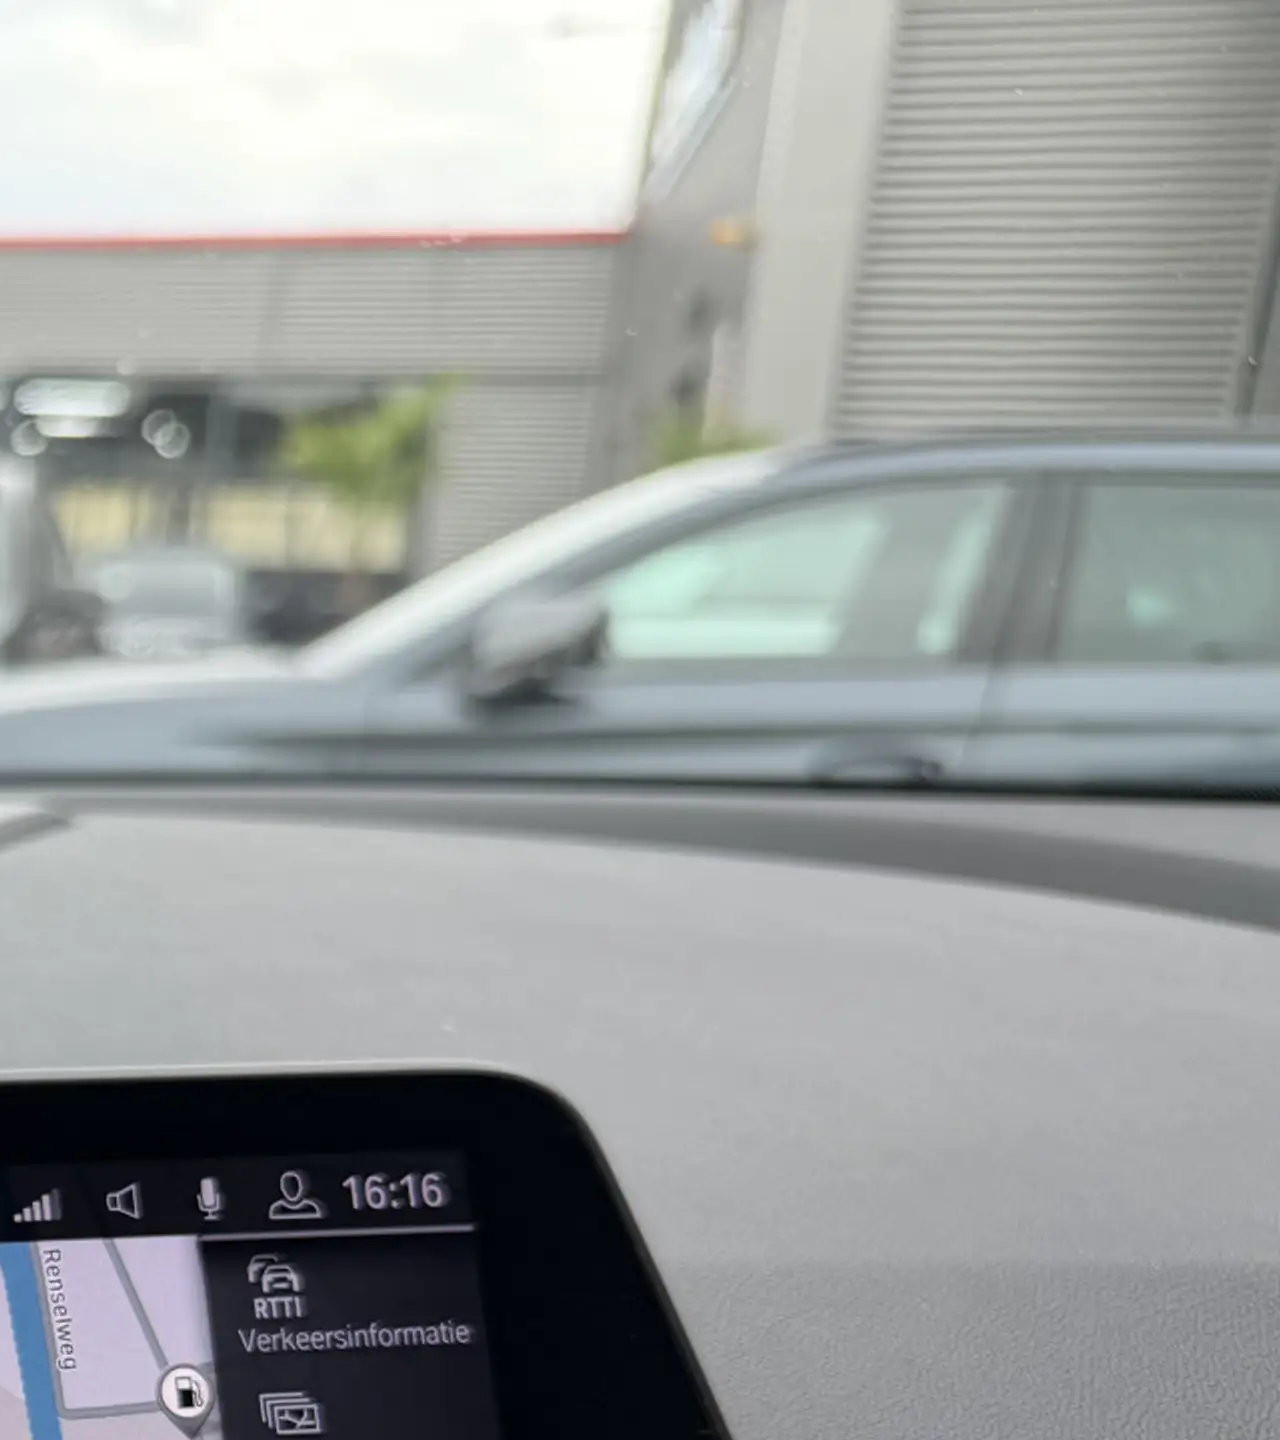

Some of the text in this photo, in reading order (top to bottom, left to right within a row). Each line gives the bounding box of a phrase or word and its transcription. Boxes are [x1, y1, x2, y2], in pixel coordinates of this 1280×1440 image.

[342, 1173, 446, 1210] 16:16
[43, 1249, 78, 1371] Renselweg
[253, 1296, 303, 1318] RTTI
[238, 1320, 470, 1353] Verkeersinformatie
